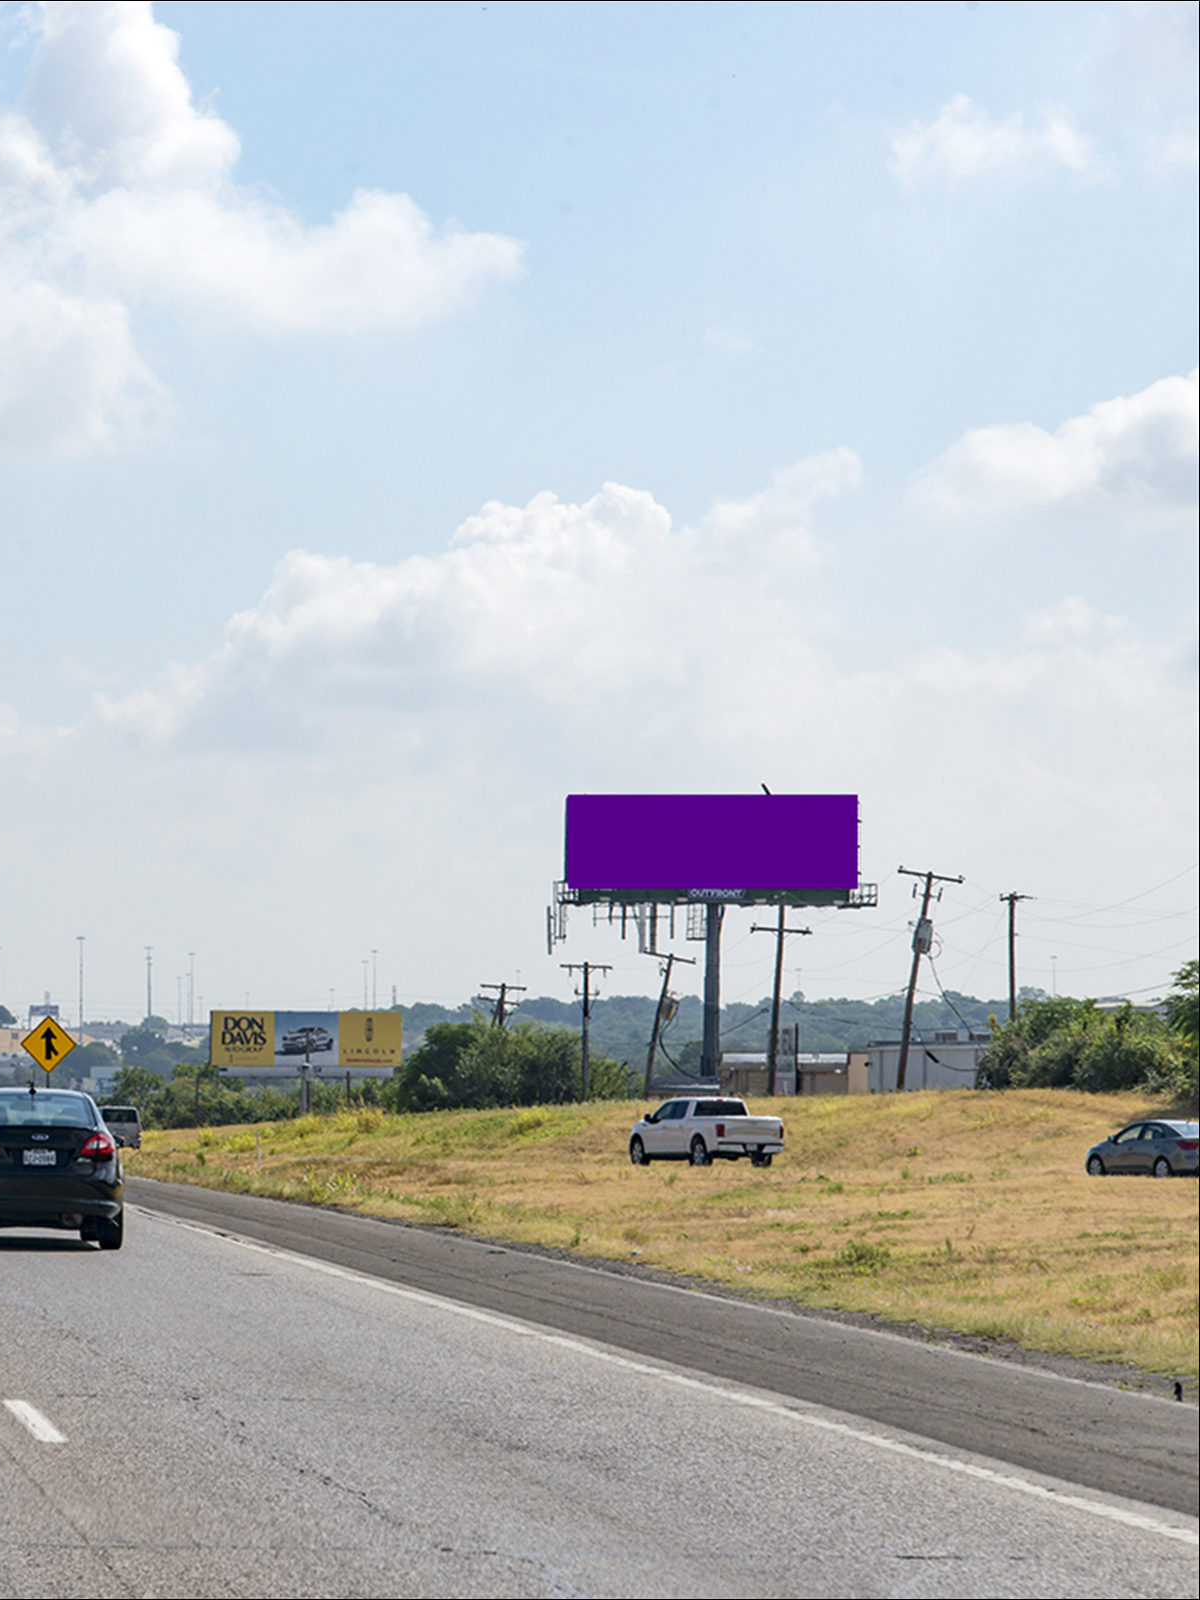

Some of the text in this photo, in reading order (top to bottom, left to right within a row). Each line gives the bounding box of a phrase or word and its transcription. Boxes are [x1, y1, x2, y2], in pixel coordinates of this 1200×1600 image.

[690, 888, 742, 898] OUTFRONT
[223, 1016, 264, 1031] DON
[221, 1031, 267, 1046] DAVIS
